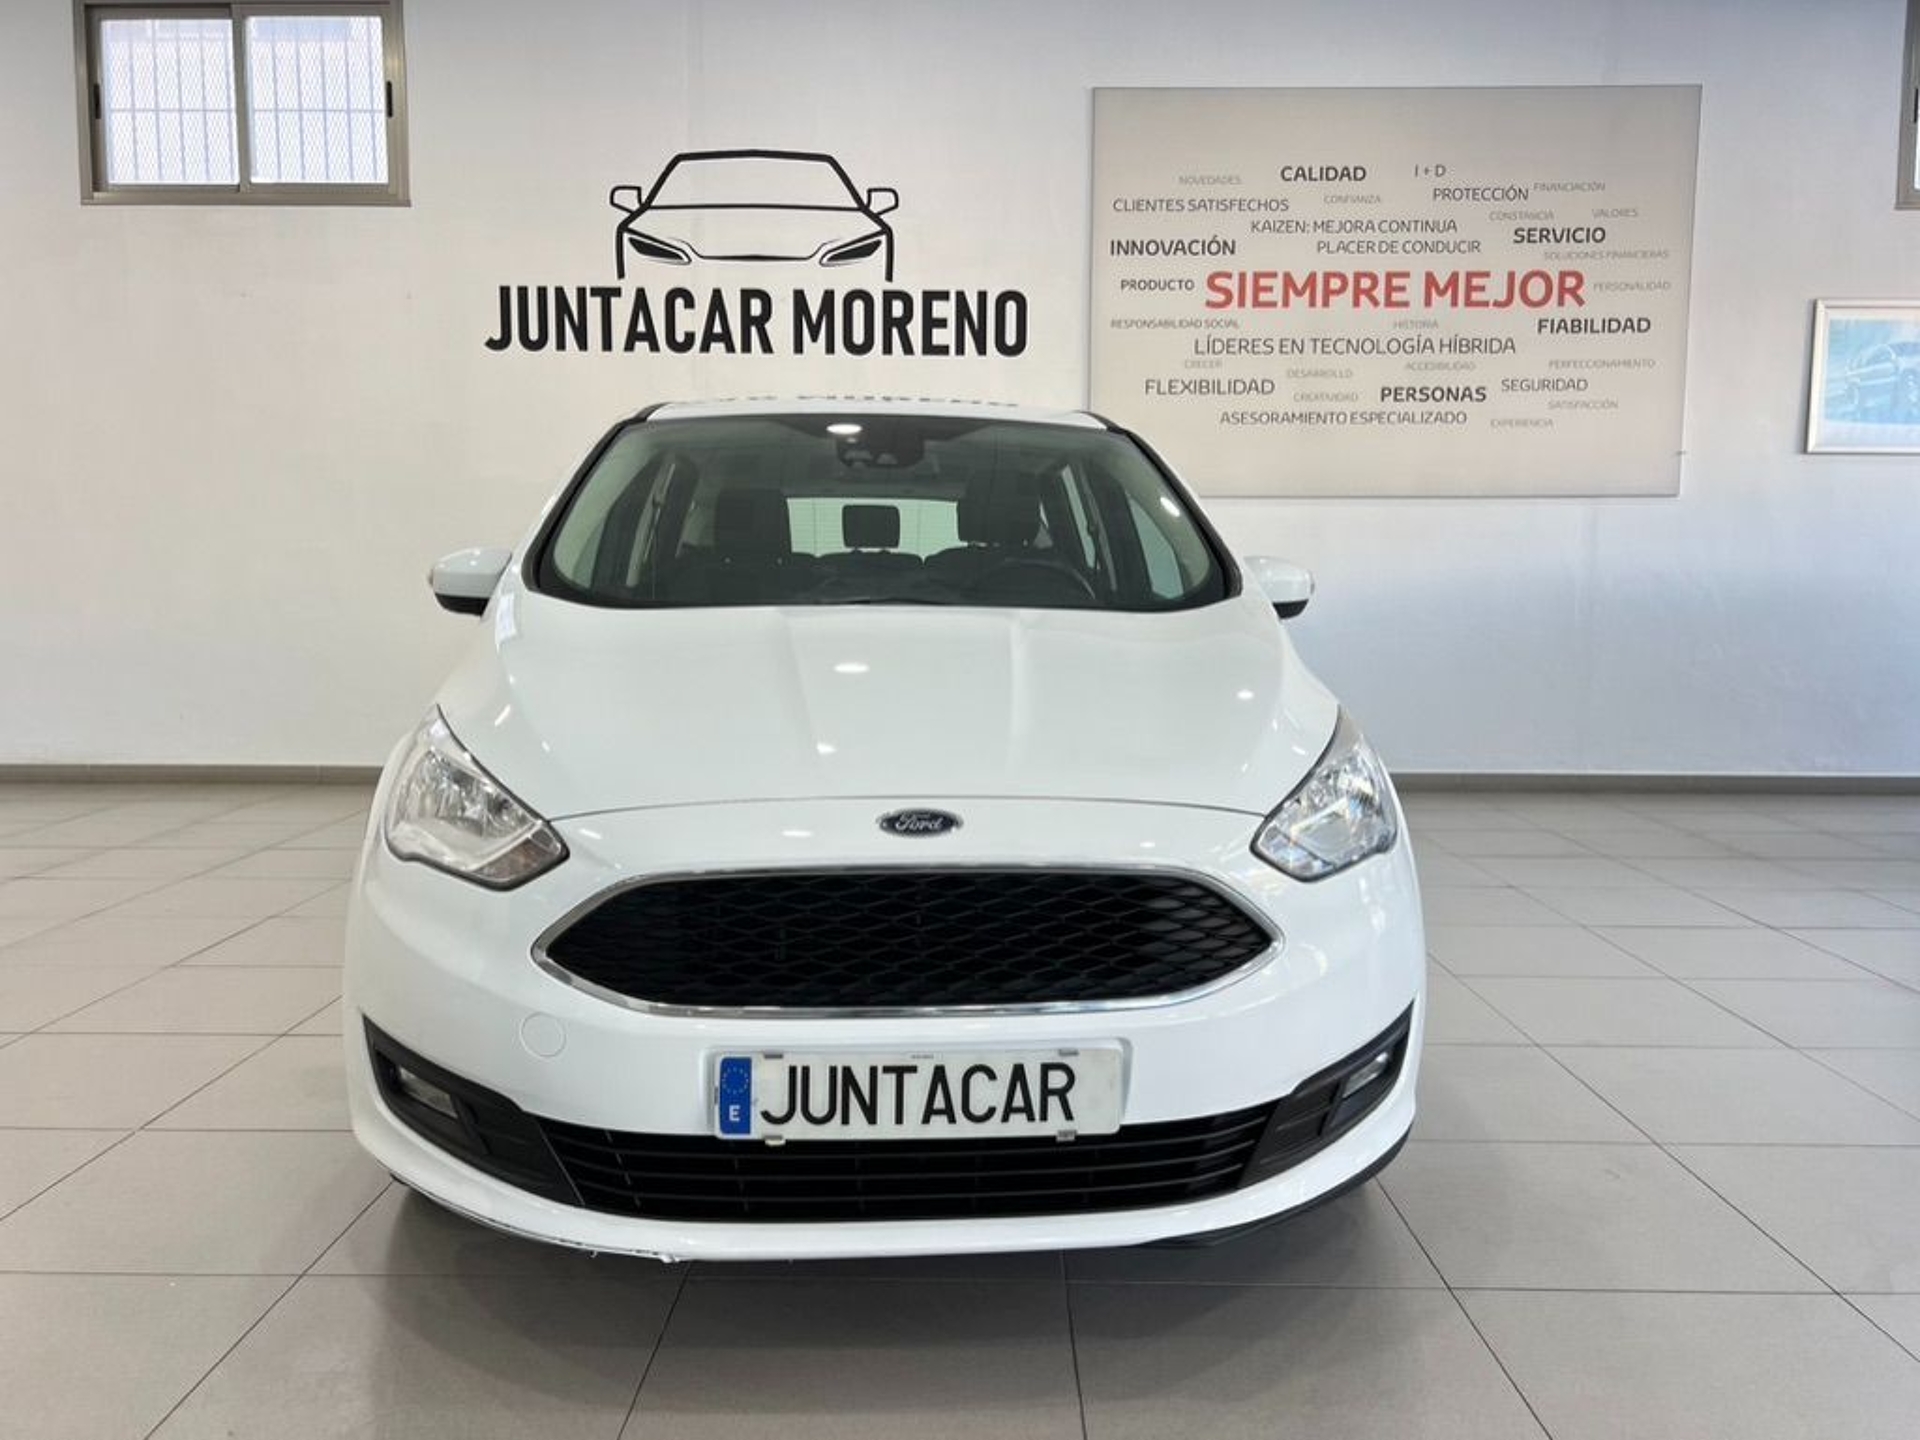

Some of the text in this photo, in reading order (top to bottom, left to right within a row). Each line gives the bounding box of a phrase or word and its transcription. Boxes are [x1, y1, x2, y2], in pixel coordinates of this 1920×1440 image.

[1280, 166, 1366, 182] CALIDAD
[1434, 164, 1446, 177] D
[1179, 175, 1242, 185] NOVEDADES
[1533, 181, 1606, 192] FINANCIACIÓN
[1323, 194, 1382, 204] CONFIANZA
[1432, 184, 1529, 201] PROTECCIÓN
[1112, 198, 1290, 212] CLIENTES SATISFECHOS
[1489, 211, 1555, 221] CONSTANCIA
[1592, 208, 1639, 218] VALORES
[1251, 219, 1458, 234] KAIZEN: MEJORA CONTINUA
[1513, 227, 1606, 244] SERVICIO
[1110, 235, 1237, 256] INNOVACIÓN
[1316, 240, 1481, 254] PLACER DE CONDUCIR
[1120, 279, 1195, 291] PRODUCTO
[1205, 269, 1586, 308] SIEMPRE MEJOR
[1593, 280, 1671, 291] PERSONALIDAD
[484, 285, 1028, 357] JUNTACAR MORENO
[1110, 319, 1239, 329] RESPONSABILIDAD SOCIAL
[1393, 319, 1439, 329] HISTORIA
[1537, 317, 1651, 334] FIABILIDAD
[1193, 333, 1517, 355] LÍDERES EN TECNOLOGÍA HÍBRIDA
[1548, 358, 1657, 369] PERFECCIONAMIENTO
[1287, 368, 1354, 379] DESARROLLO
[1144, 378, 1276, 396] FLEXIBILIDAD
[1500, 378, 1589, 393] SEGURIDAD
[1381, 386, 1487, 402] PERSONAS
[1547, 398, 1619, 410] SATISFACCIÓN
[1220, 410, 1468, 426] ASESORAMIENTO ESPECIALIZADO
[895, 811, 943, 832] Ford
[760, 1061, 1077, 1126] JUNTACAR
[728, 1105, 741, 1123] E
